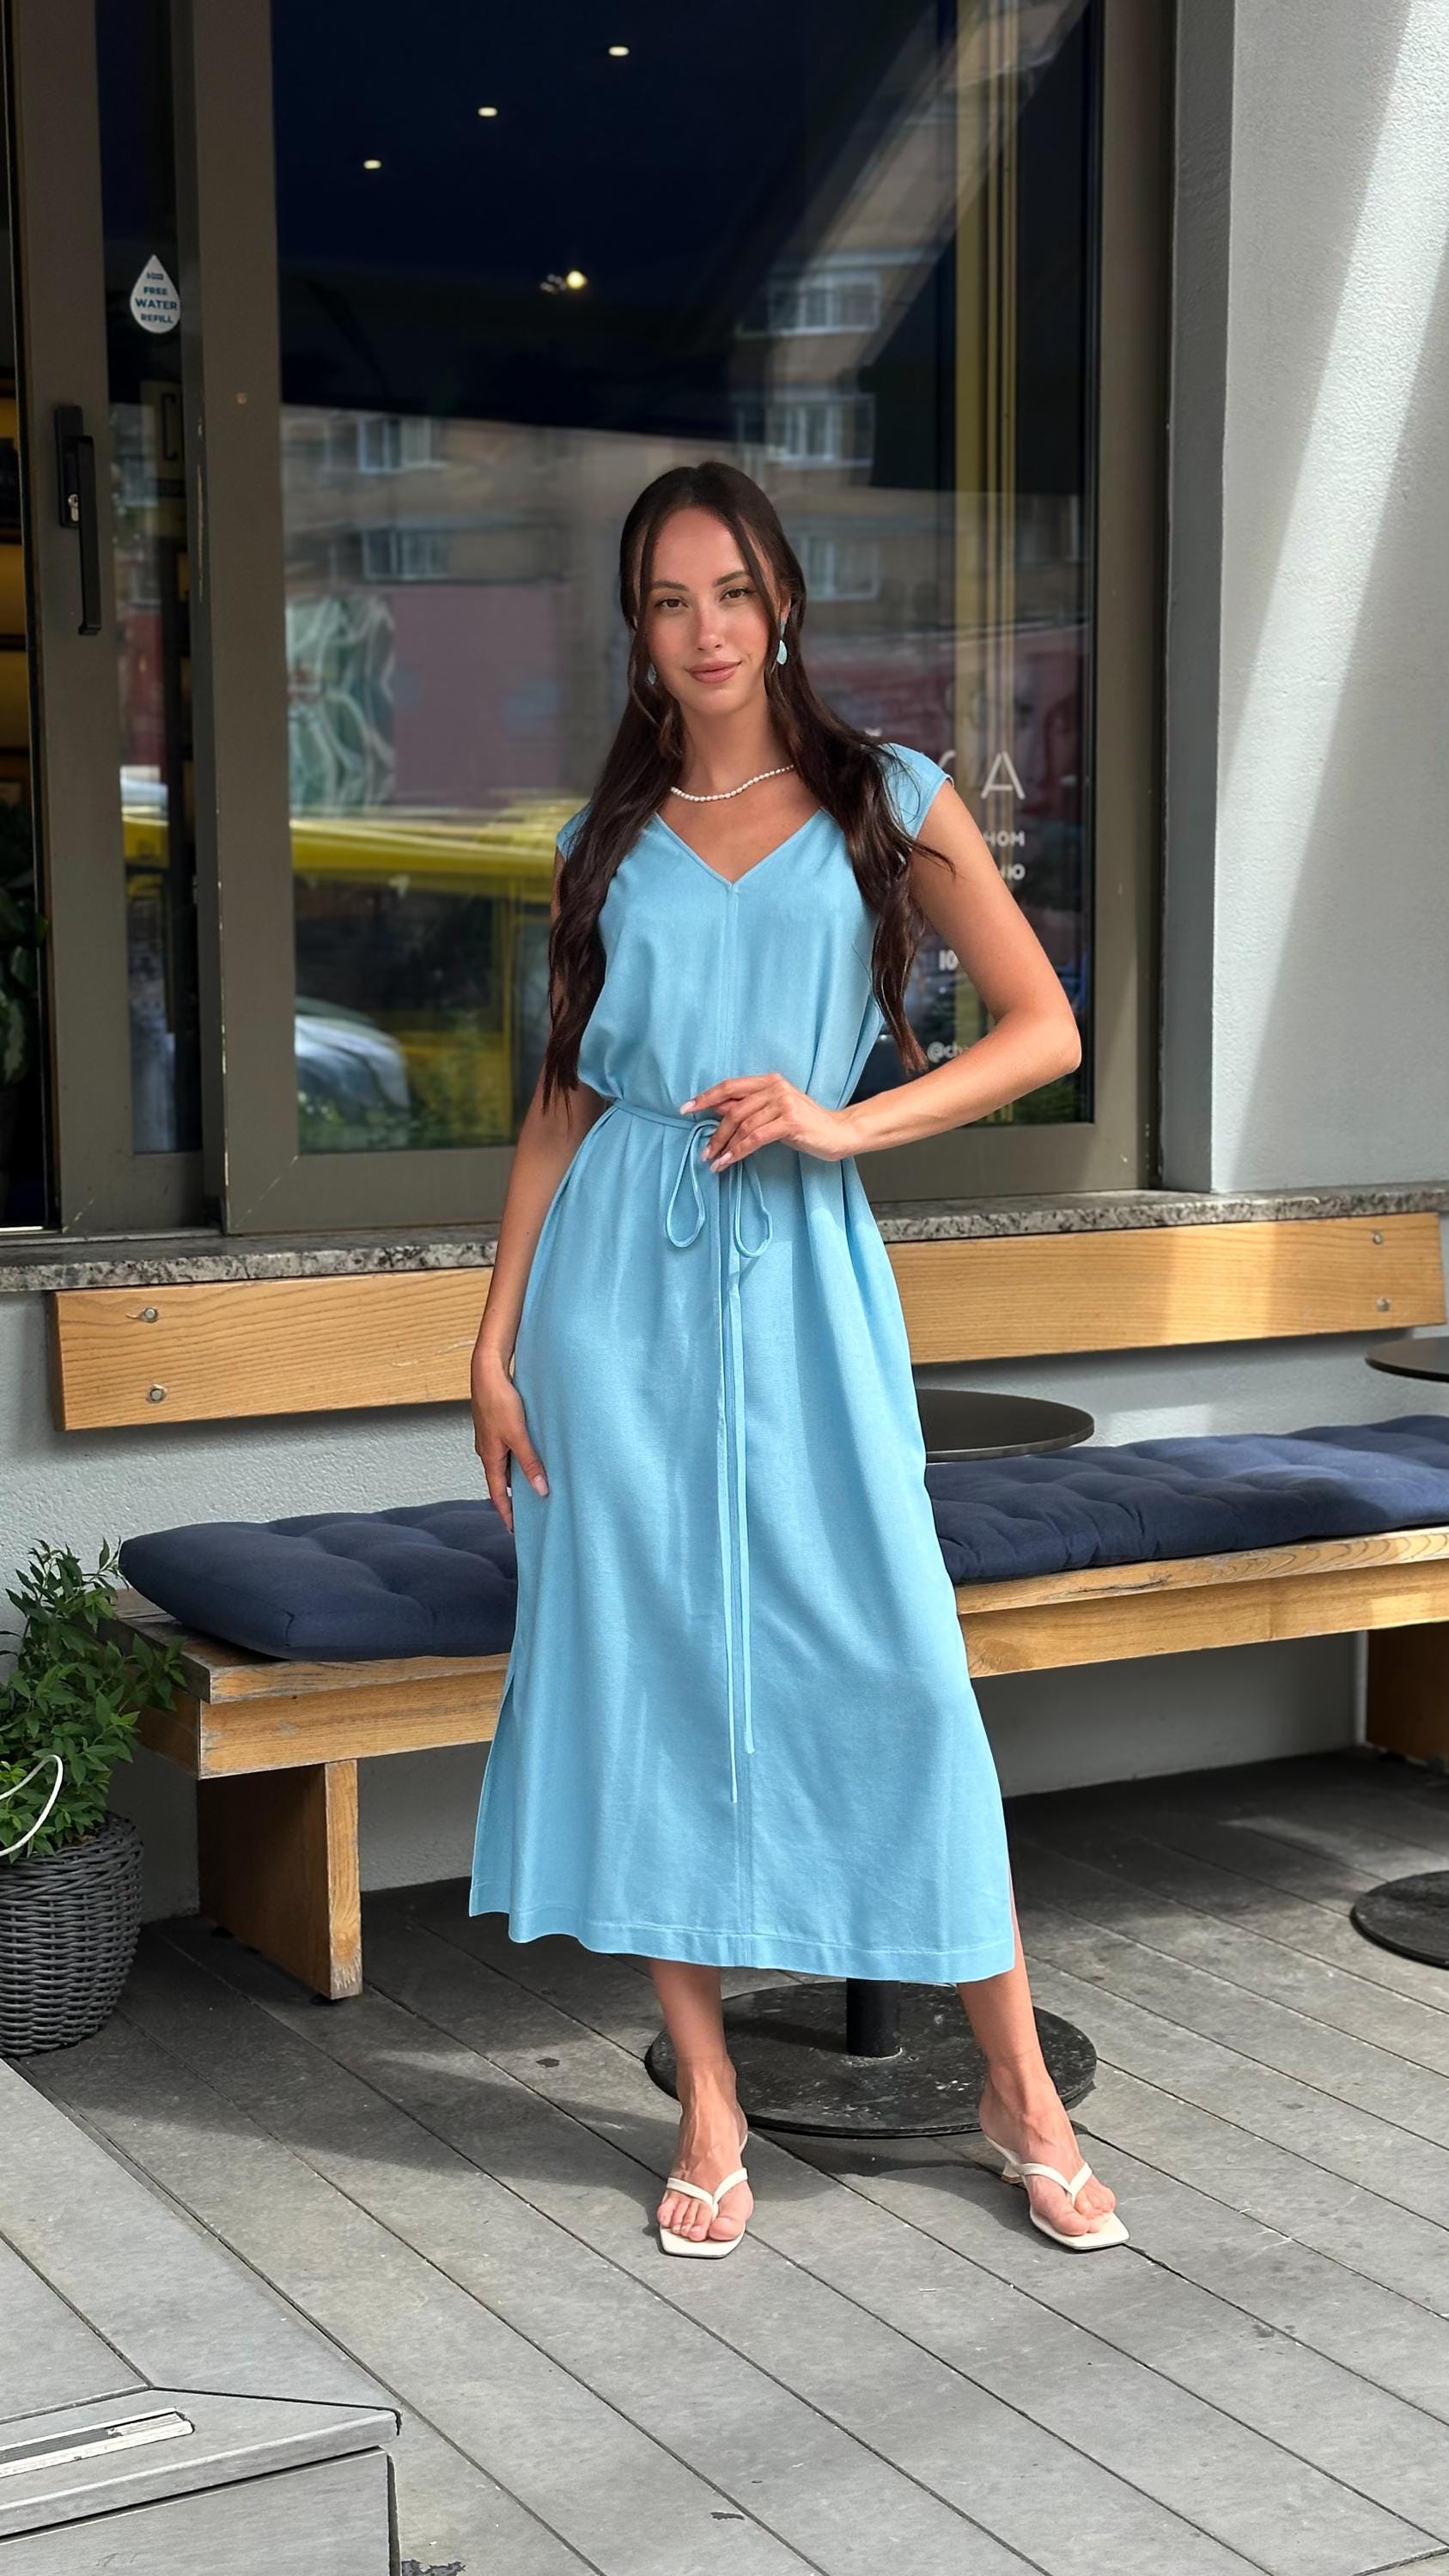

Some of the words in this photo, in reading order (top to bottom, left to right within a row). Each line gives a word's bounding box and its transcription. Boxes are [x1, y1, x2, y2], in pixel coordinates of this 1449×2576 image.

[144, 286, 167, 295] FREE
[135, 297, 178, 311] WATER
[140, 313, 174, 324] REFILL
